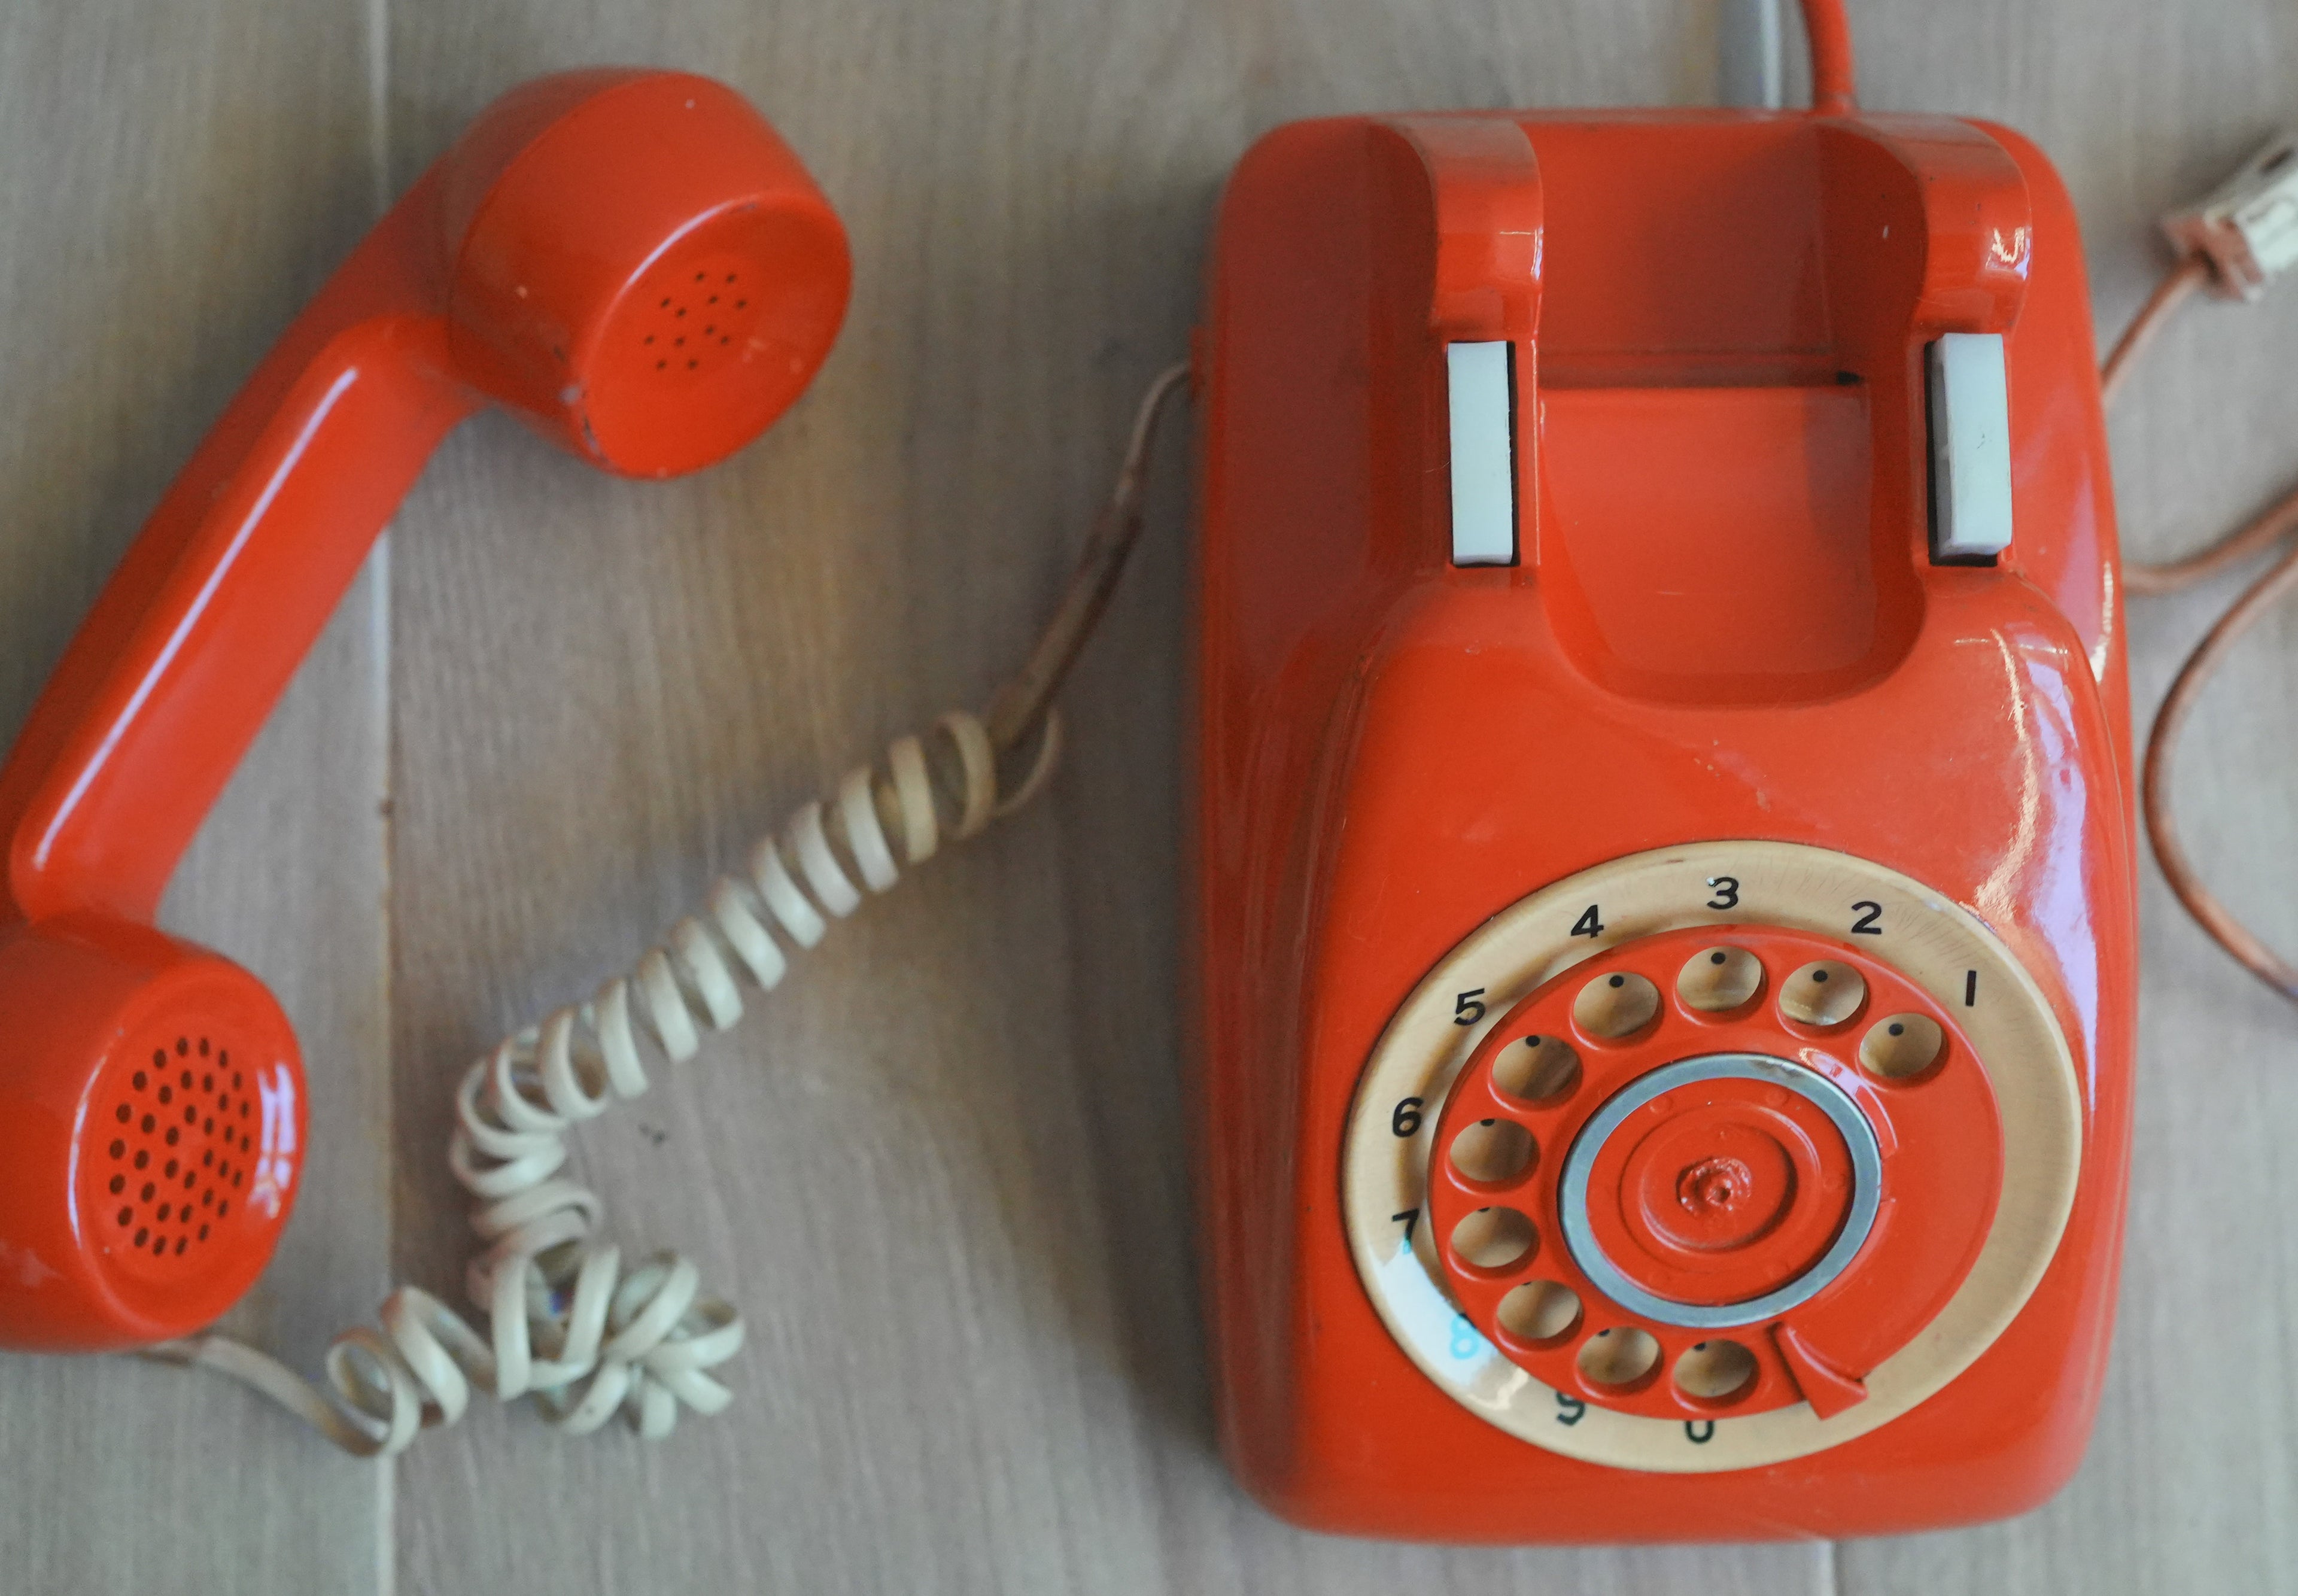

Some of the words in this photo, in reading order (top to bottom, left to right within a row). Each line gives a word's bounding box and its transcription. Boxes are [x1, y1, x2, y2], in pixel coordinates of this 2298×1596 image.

[1706, 877, 1740, 910] 3
[1570, 904, 1604, 938] 4
[1850, 901, 1883, 935] 2
[1454, 988, 1486, 1026] 5
[1965, 970, 1977, 1007] 1
[1392, 1097, 1424, 1138] 6
[1392, 1208, 1420, 1254] 7
[1450, 1313, 1480, 1360] 8
